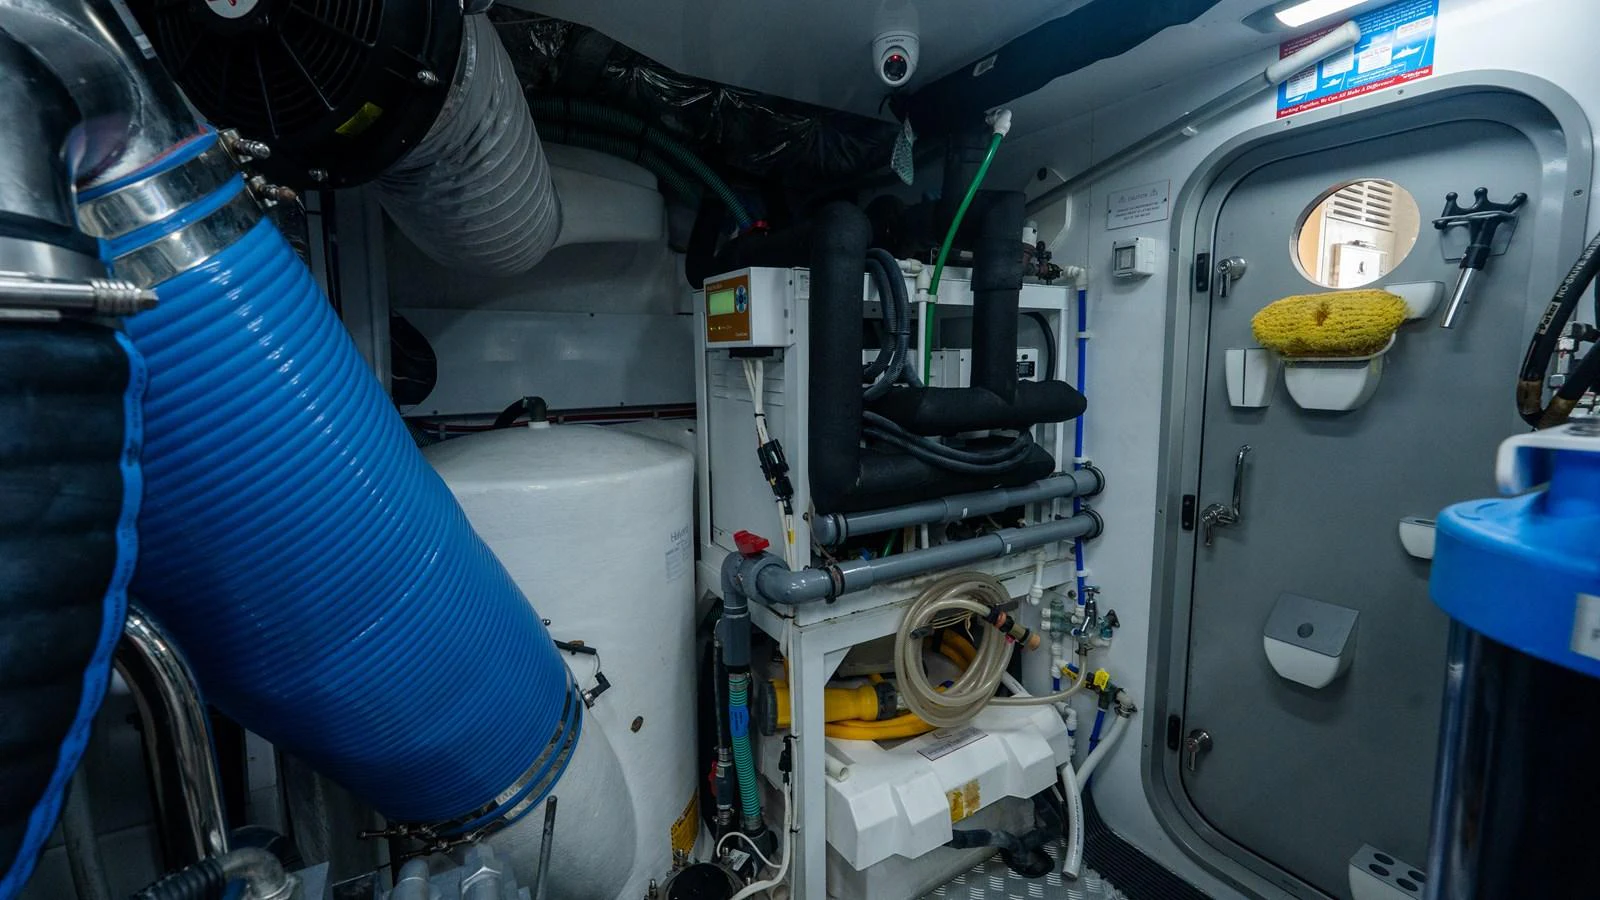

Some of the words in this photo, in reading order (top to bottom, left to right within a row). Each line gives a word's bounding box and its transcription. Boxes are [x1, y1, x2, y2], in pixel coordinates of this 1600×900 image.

[1328, 95, 1339, 103] Can
[1347, 88, 1361, 97] Make
[1540, 303, 1558, 331] Parker
